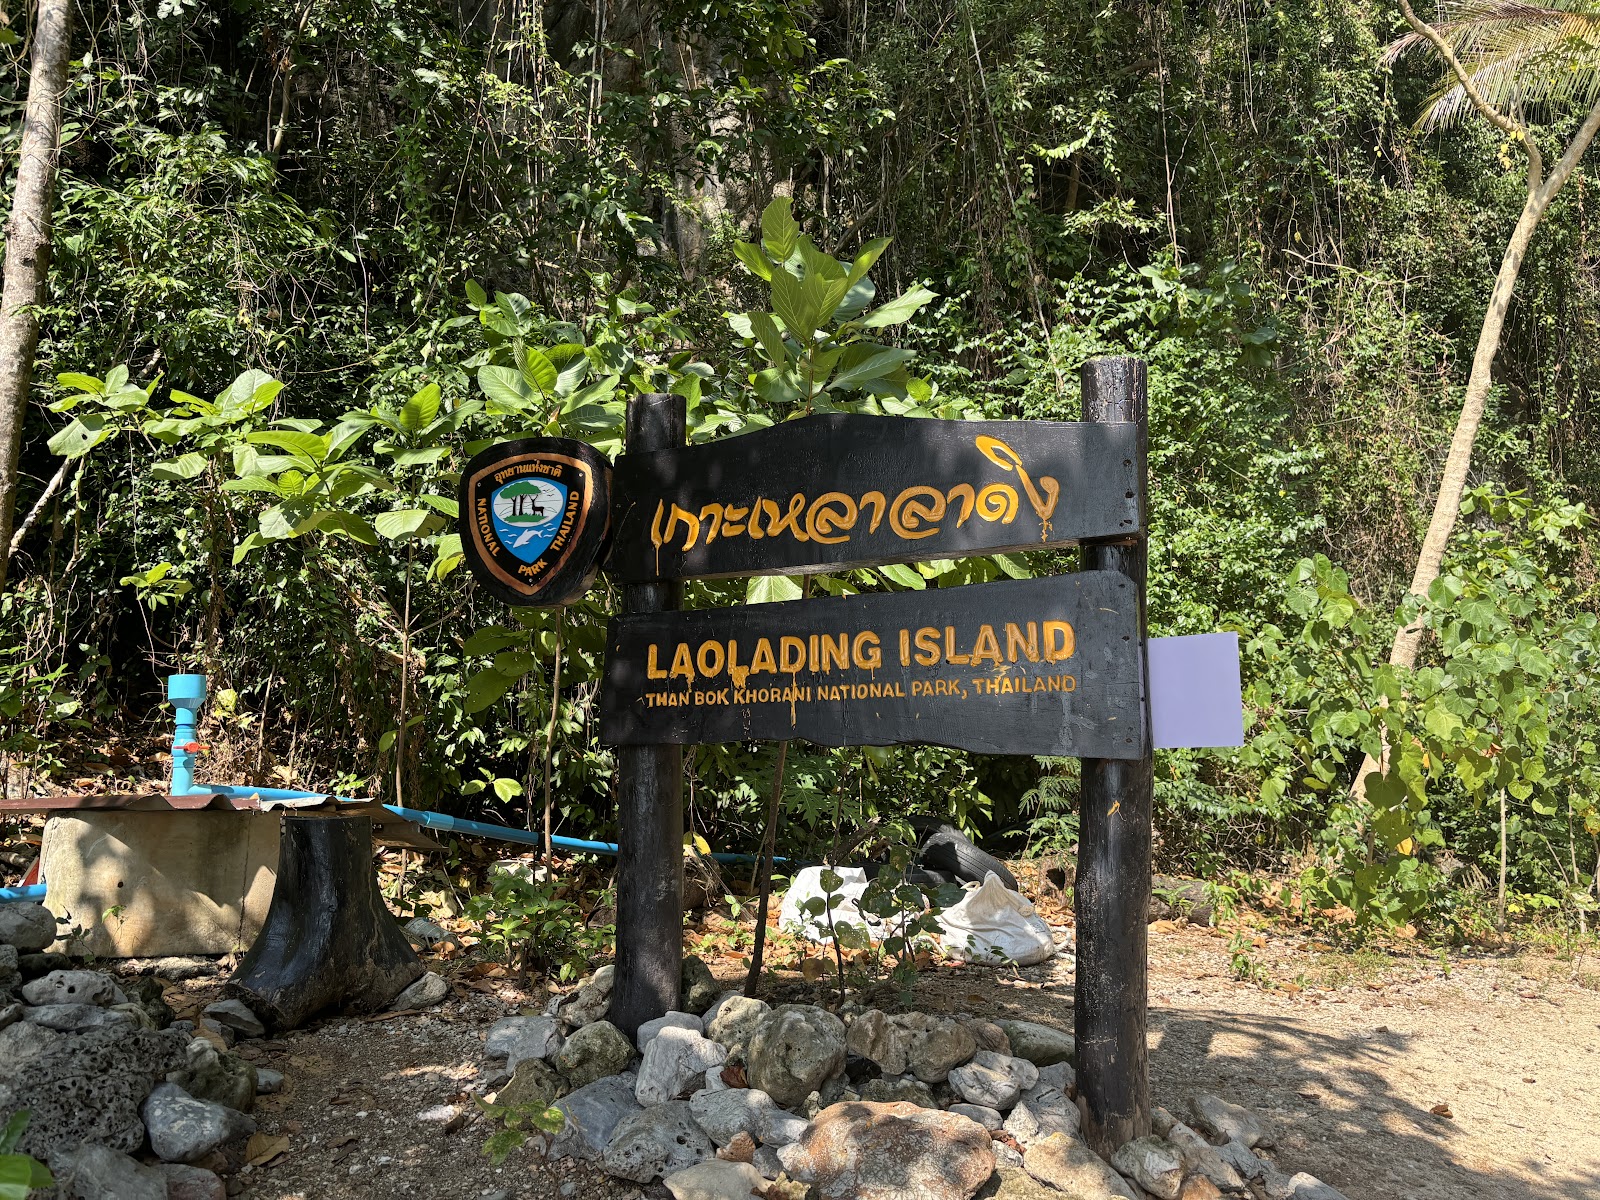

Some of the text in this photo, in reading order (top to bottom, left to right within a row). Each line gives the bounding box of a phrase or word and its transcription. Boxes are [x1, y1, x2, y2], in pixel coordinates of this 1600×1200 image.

[495, 461, 562, 483] อุทยานแห่งชาติ
[478, 491, 579, 576] NATIONAL PARK THAILAND
[648, 620, 1075, 679] LAOLADING ISLAND
[645, 675, 1076, 707] THAN BOK KHORANI NATIONAL PARK, THAILAND
